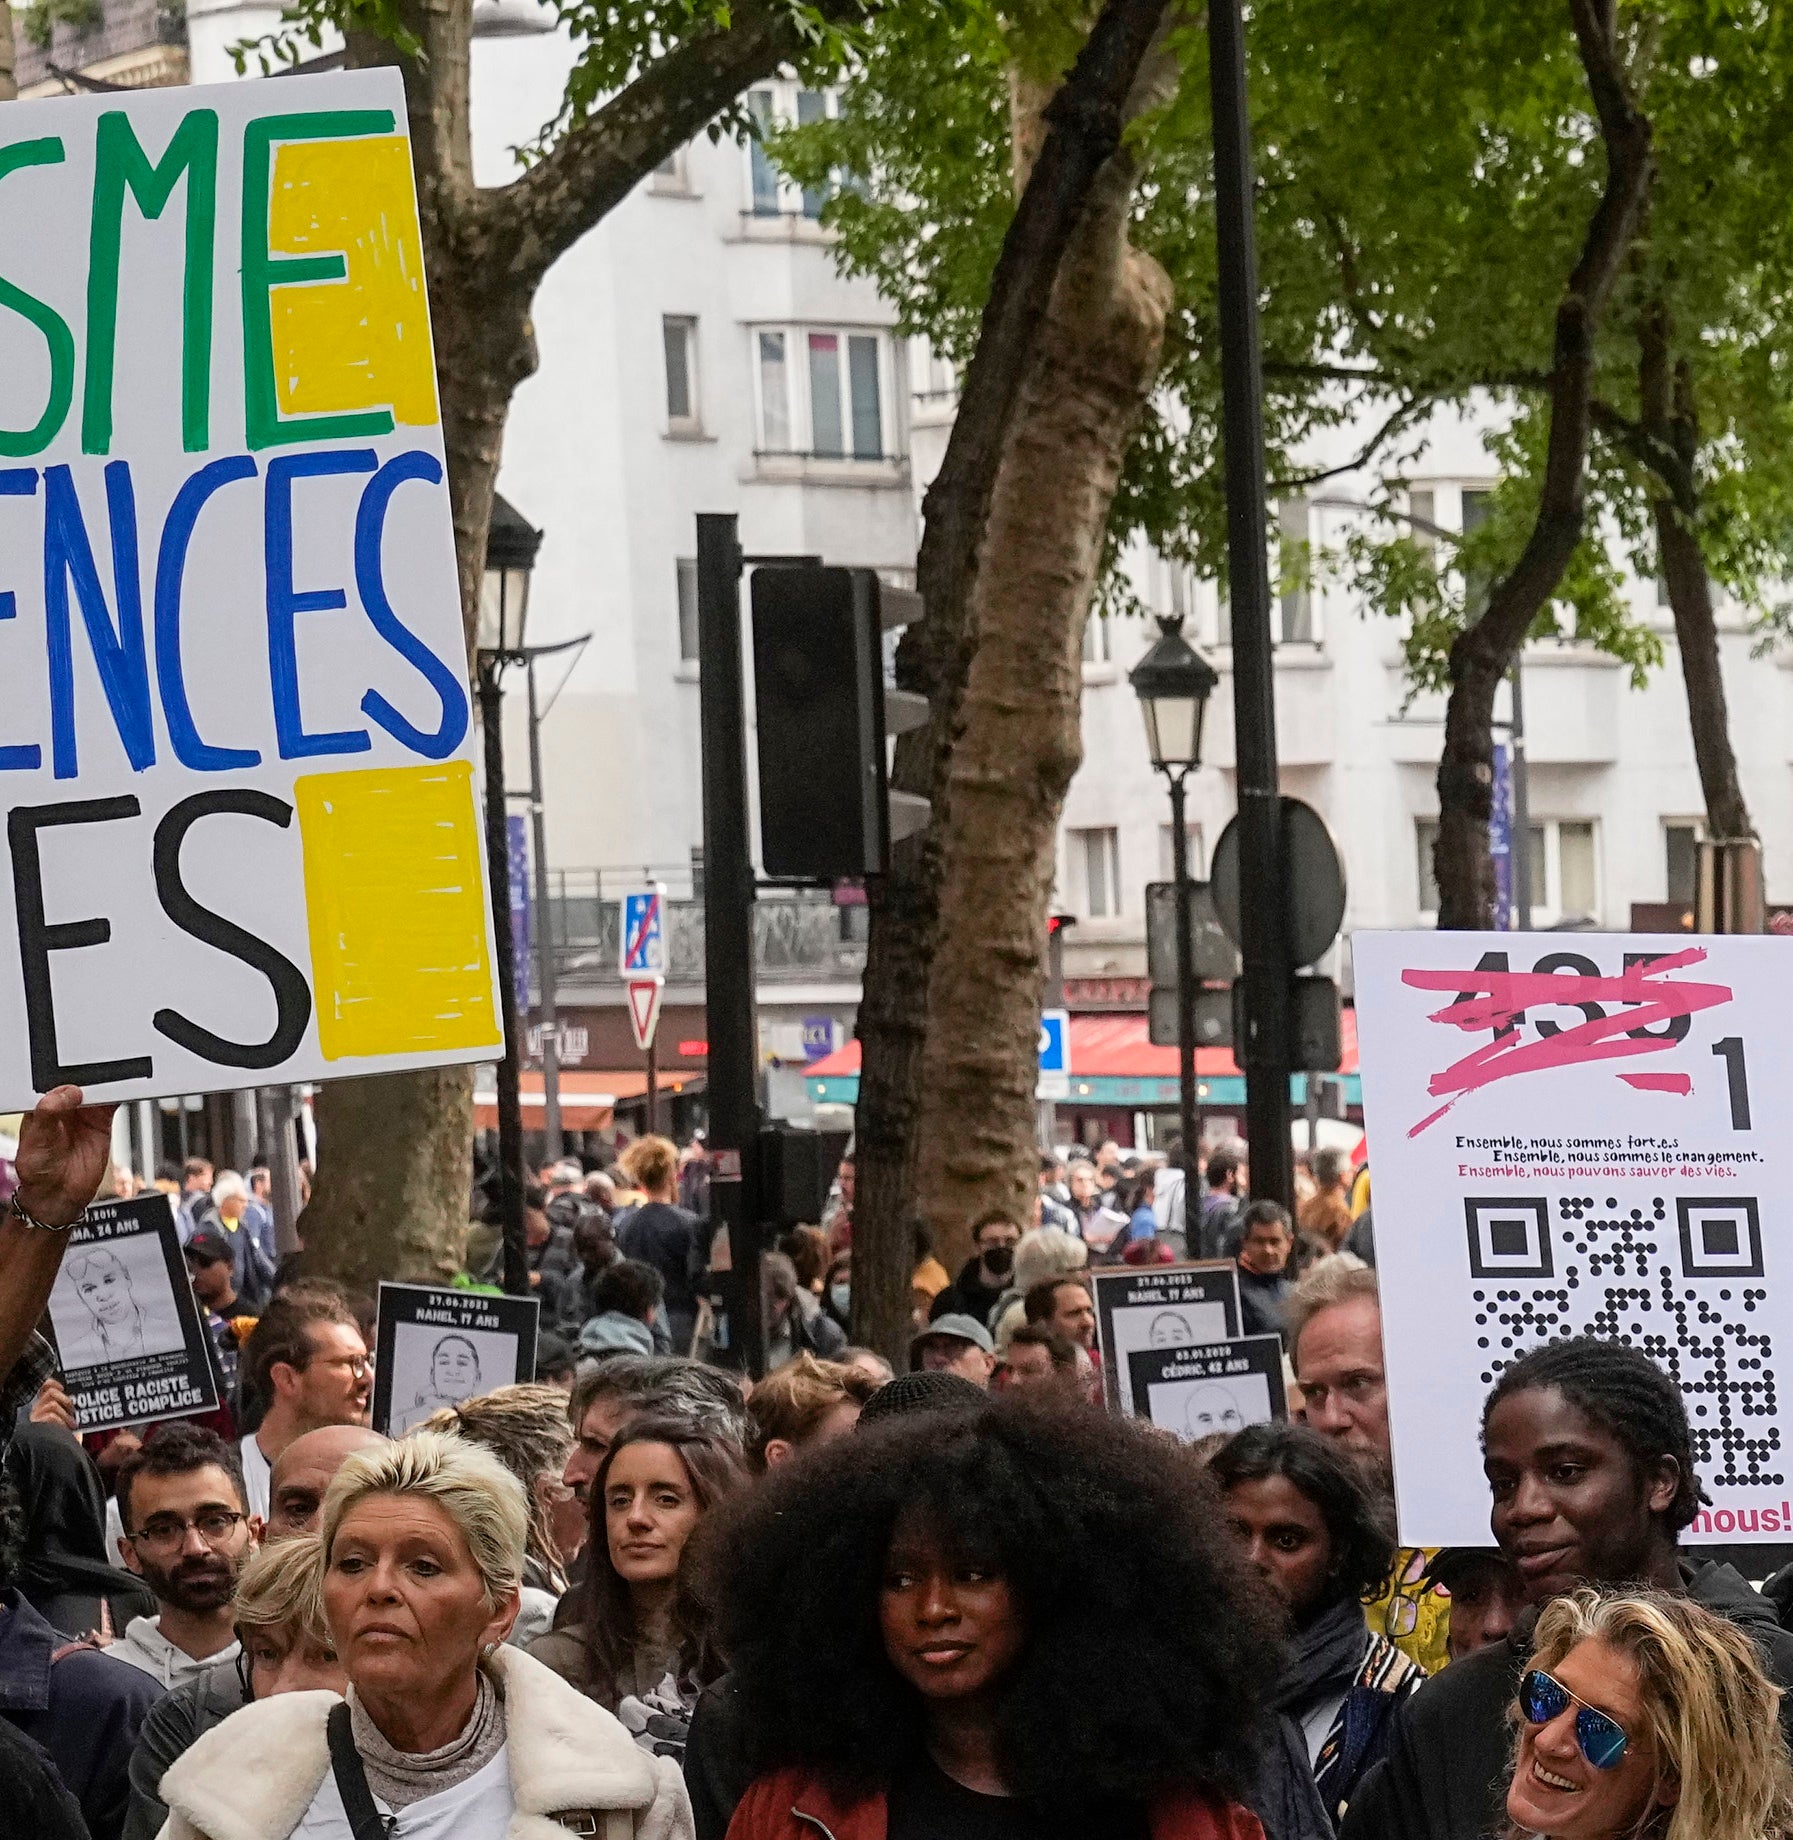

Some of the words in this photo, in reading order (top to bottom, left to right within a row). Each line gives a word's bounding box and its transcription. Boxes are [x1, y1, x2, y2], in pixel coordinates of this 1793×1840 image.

[8, 789, 312, 1093] ES
[1711, 1036, 1752, 1131] 1
[1530, 1139, 1562, 1149] nous
[1566, 1138, 1622, 1149] sommes
[1567, 1152, 1600, 1163] nous
[1603, 1152, 1659, 1163] sommes
[1533, 1167, 1565, 1177] nous
[1568, 1167, 1626, 1179] pouvons
[1629, 1165, 1676, 1177] sauver
[1680, 1164, 1702, 1177] des
[1704, 1164, 1737, 1177] vies.
[115, 1218, 140, 1234] ANS
[475, 1314, 500, 1328] ANS
[1225, 1359, 1250, 1372] ANS
[124, 1375, 190, 1400] RACISTE
[127, 1388, 203, 1416] COMPLICE
